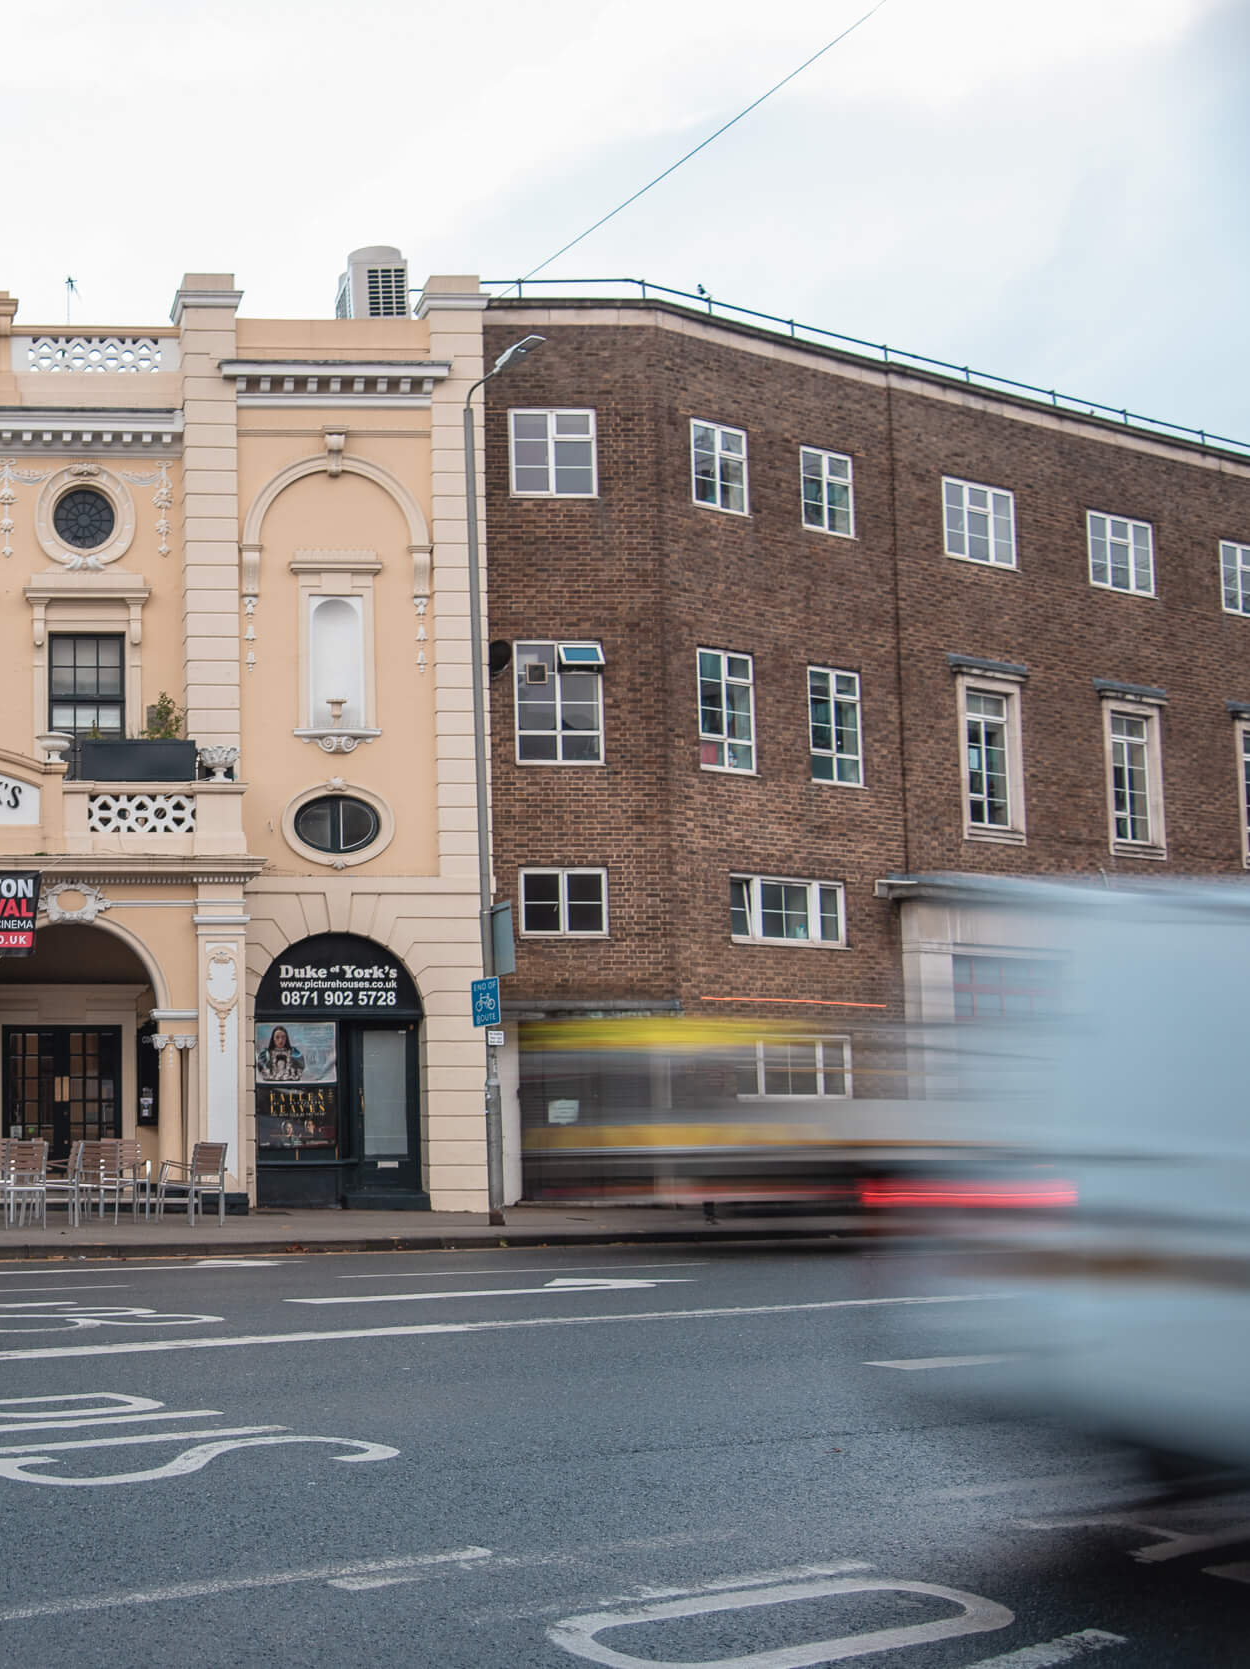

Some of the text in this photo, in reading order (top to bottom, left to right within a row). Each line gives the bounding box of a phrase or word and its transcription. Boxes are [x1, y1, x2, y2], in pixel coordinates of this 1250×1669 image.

[279, 964, 398, 979] Duke of York's
[280, 979, 398, 989] www.picturehouses.co.uk
[473, 981, 496, 992] END OF
[281, 991, 397, 1006] 0871 902 5728
